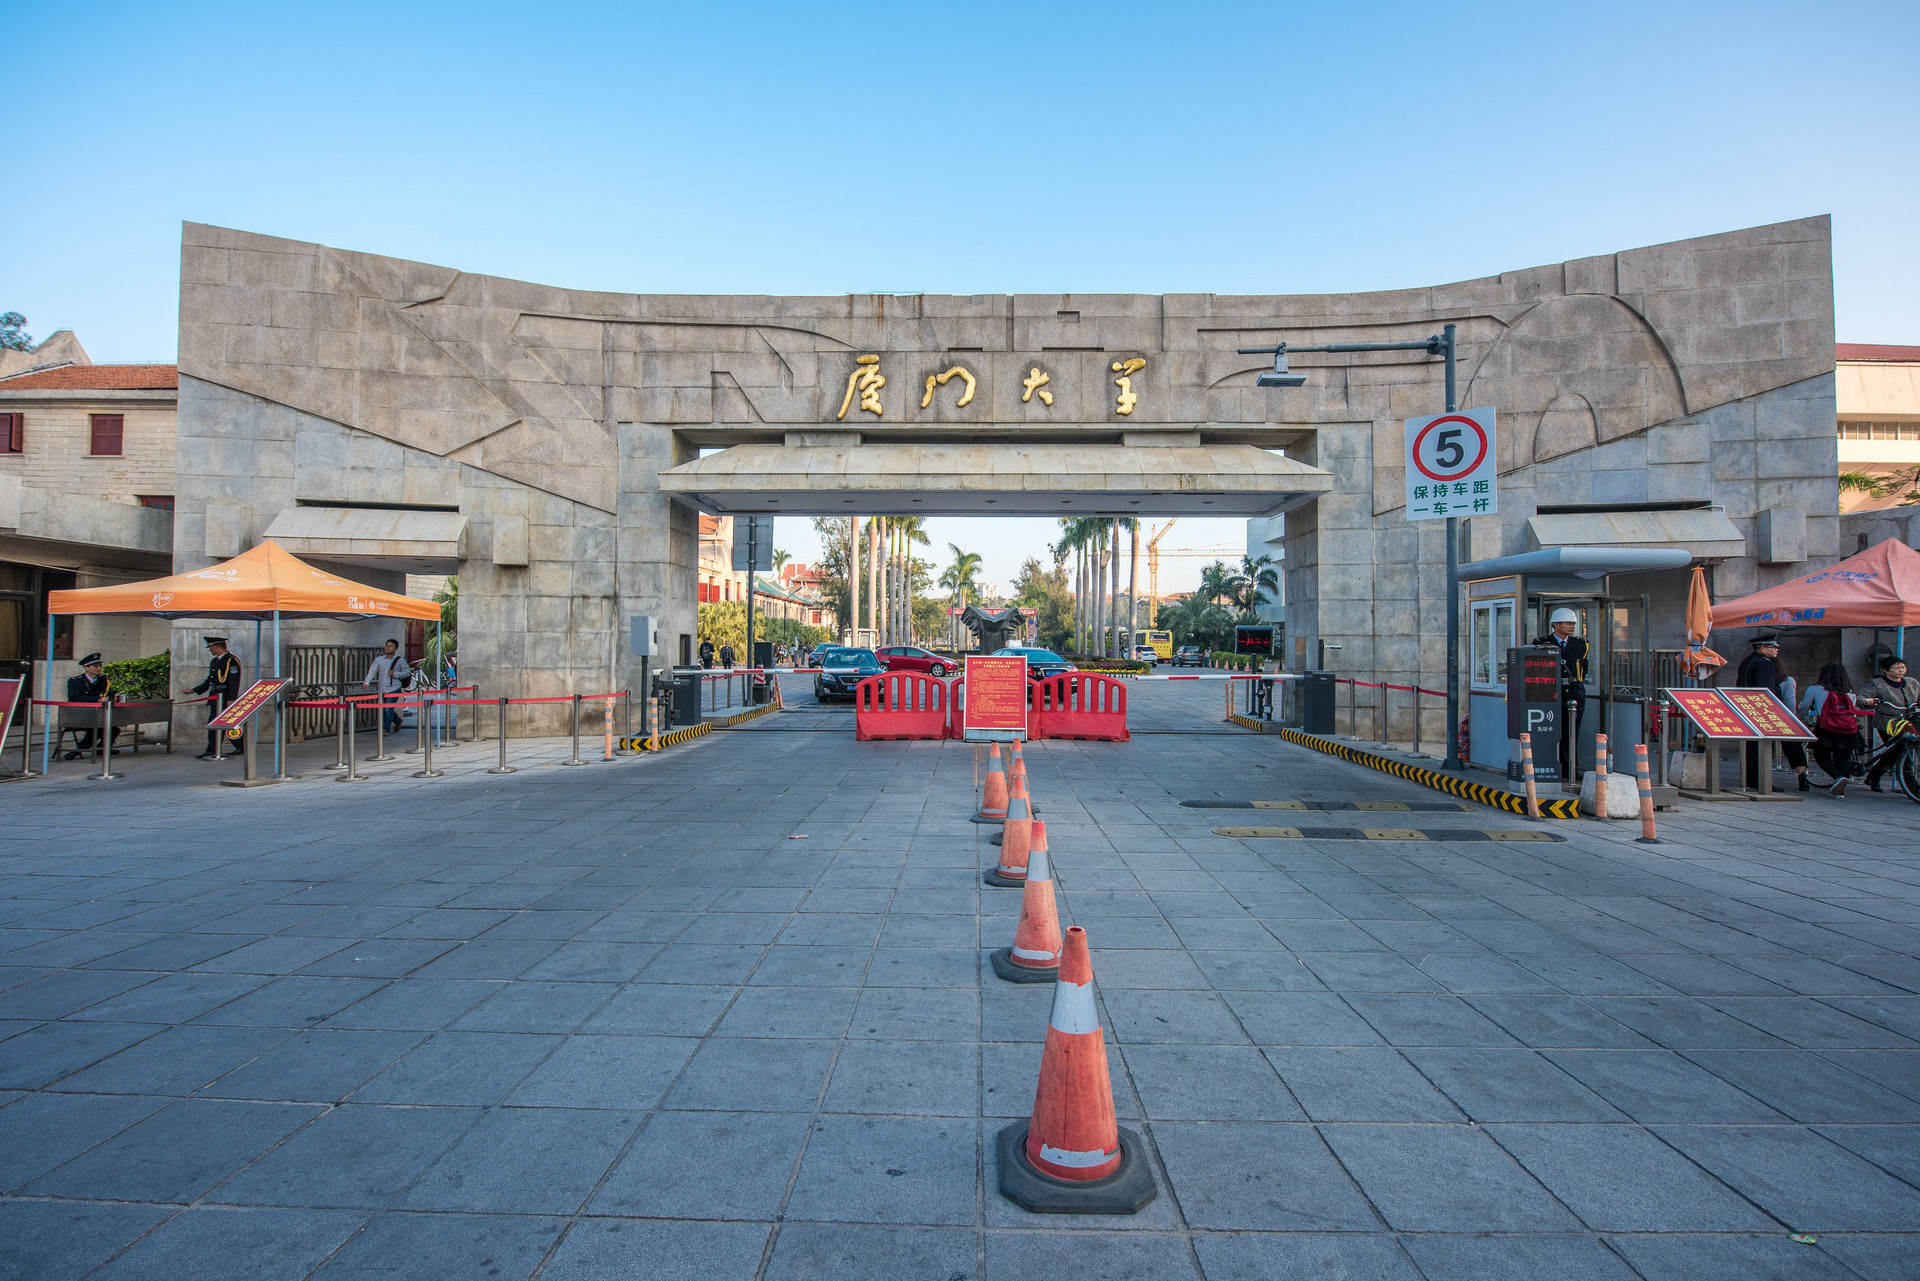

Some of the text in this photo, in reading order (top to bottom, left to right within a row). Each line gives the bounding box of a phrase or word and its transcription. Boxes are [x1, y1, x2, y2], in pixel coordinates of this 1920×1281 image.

[1435, 429, 1465, 468] 5
[1413, 480, 1490, 500] 保持车距
[1413, 498, 1490, 515] 一车一杆
[1527, 709, 1545, 732] P
[1747, 694, 1796, 735] 校内人员通道
